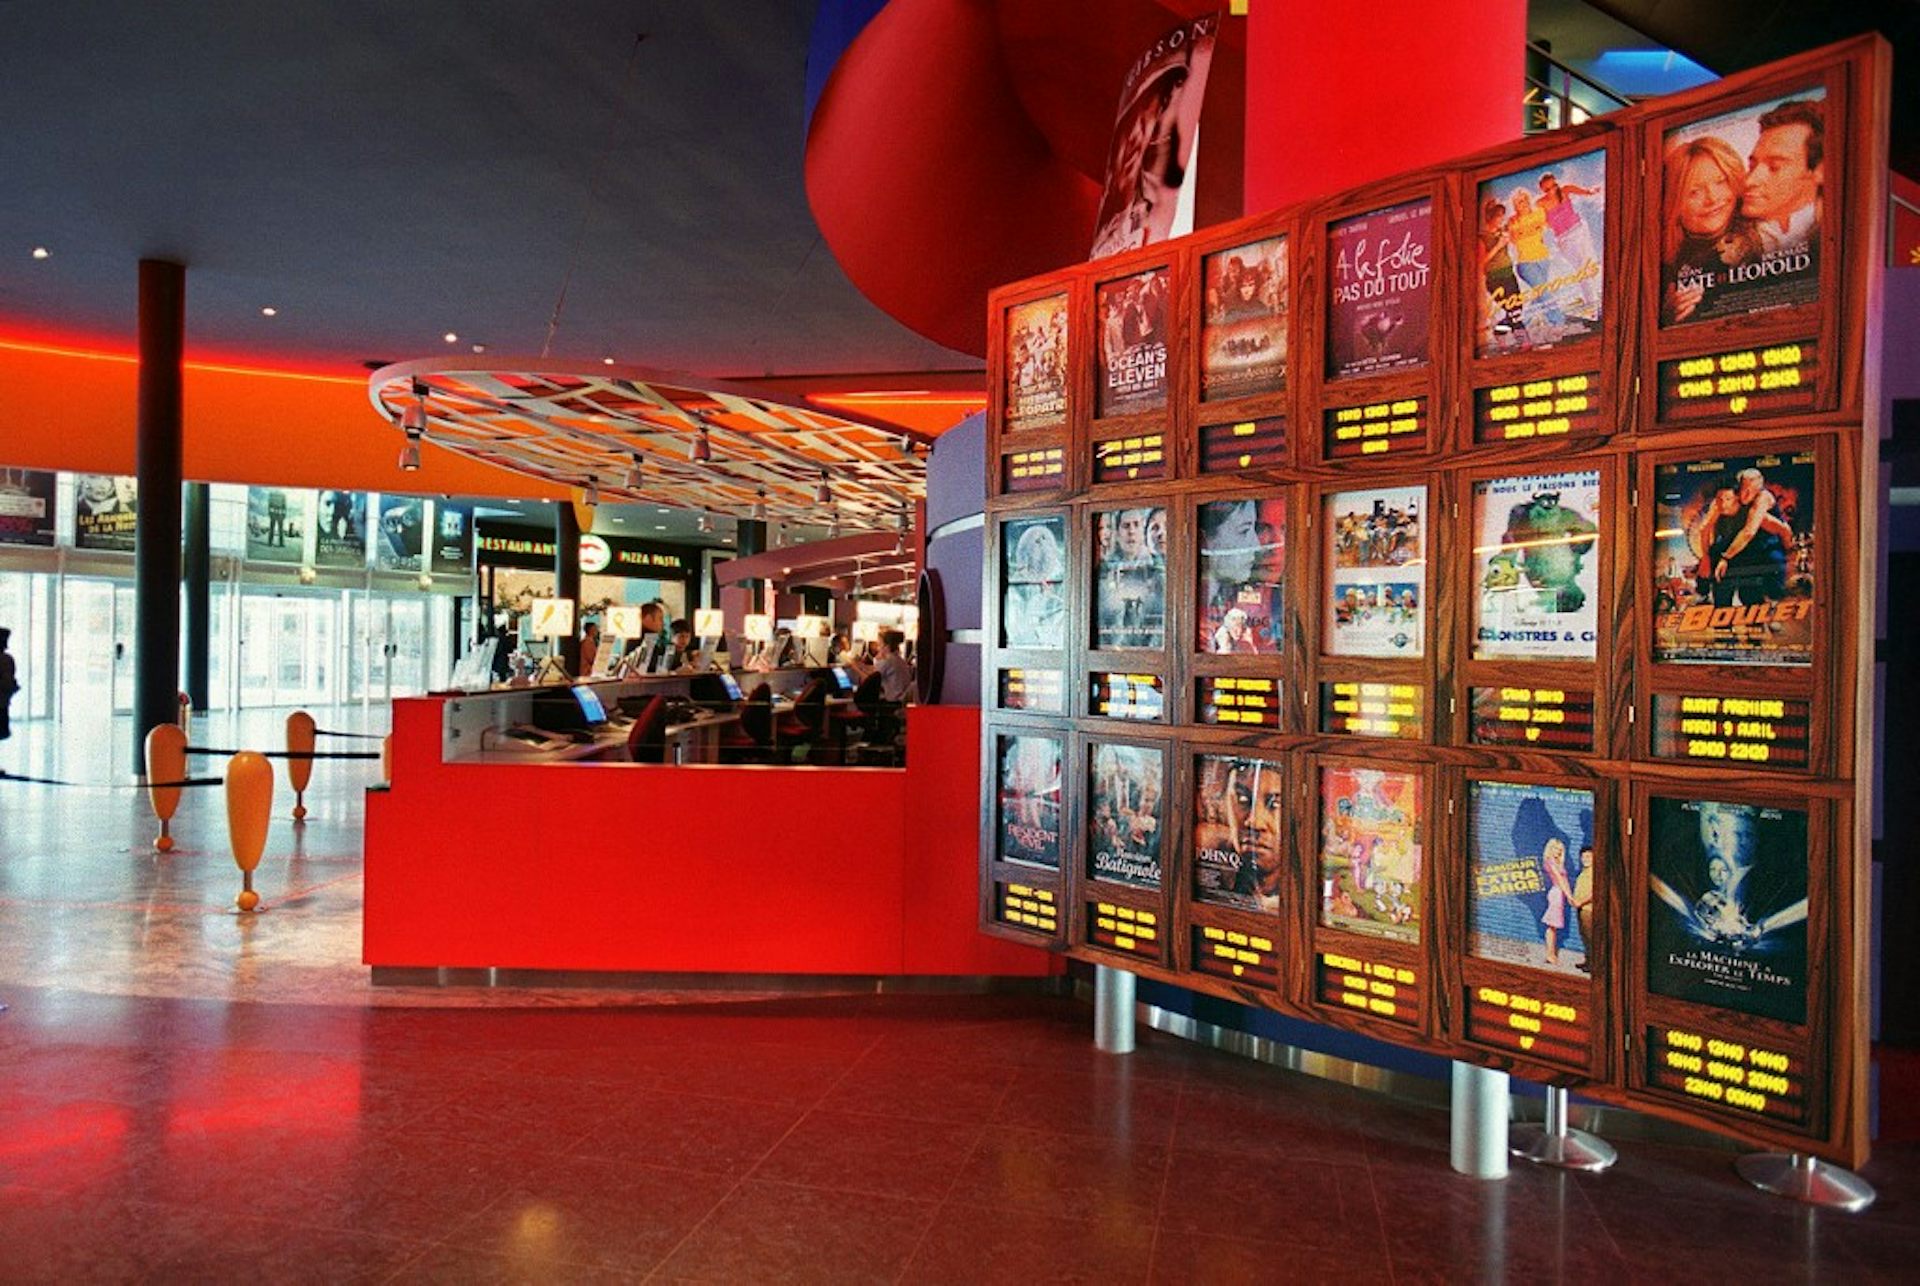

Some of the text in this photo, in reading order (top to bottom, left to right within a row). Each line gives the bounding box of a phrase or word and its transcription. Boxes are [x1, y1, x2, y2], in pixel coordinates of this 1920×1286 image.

[1334, 282, 1361, 305] PAS
[1364, 278, 1385, 299] DU
[1388, 267, 1430, 293] TOUT
[1677, 272, 1716, 293] KATE
[1109, 361, 1166, 388] ELEVEN
[618, 551, 681, 567] PIZZA PASTA
[1677, 600, 1814, 634] BOULET
[1095, 852, 1162, 880] Batignole
[1478, 880, 1541, 897] LARGE
[1669, 953, 1731, 975] EXPLORER
[1749, 966, 1792, 986] TEMPS
[1700, 950, 1759, 972] MACHINE
